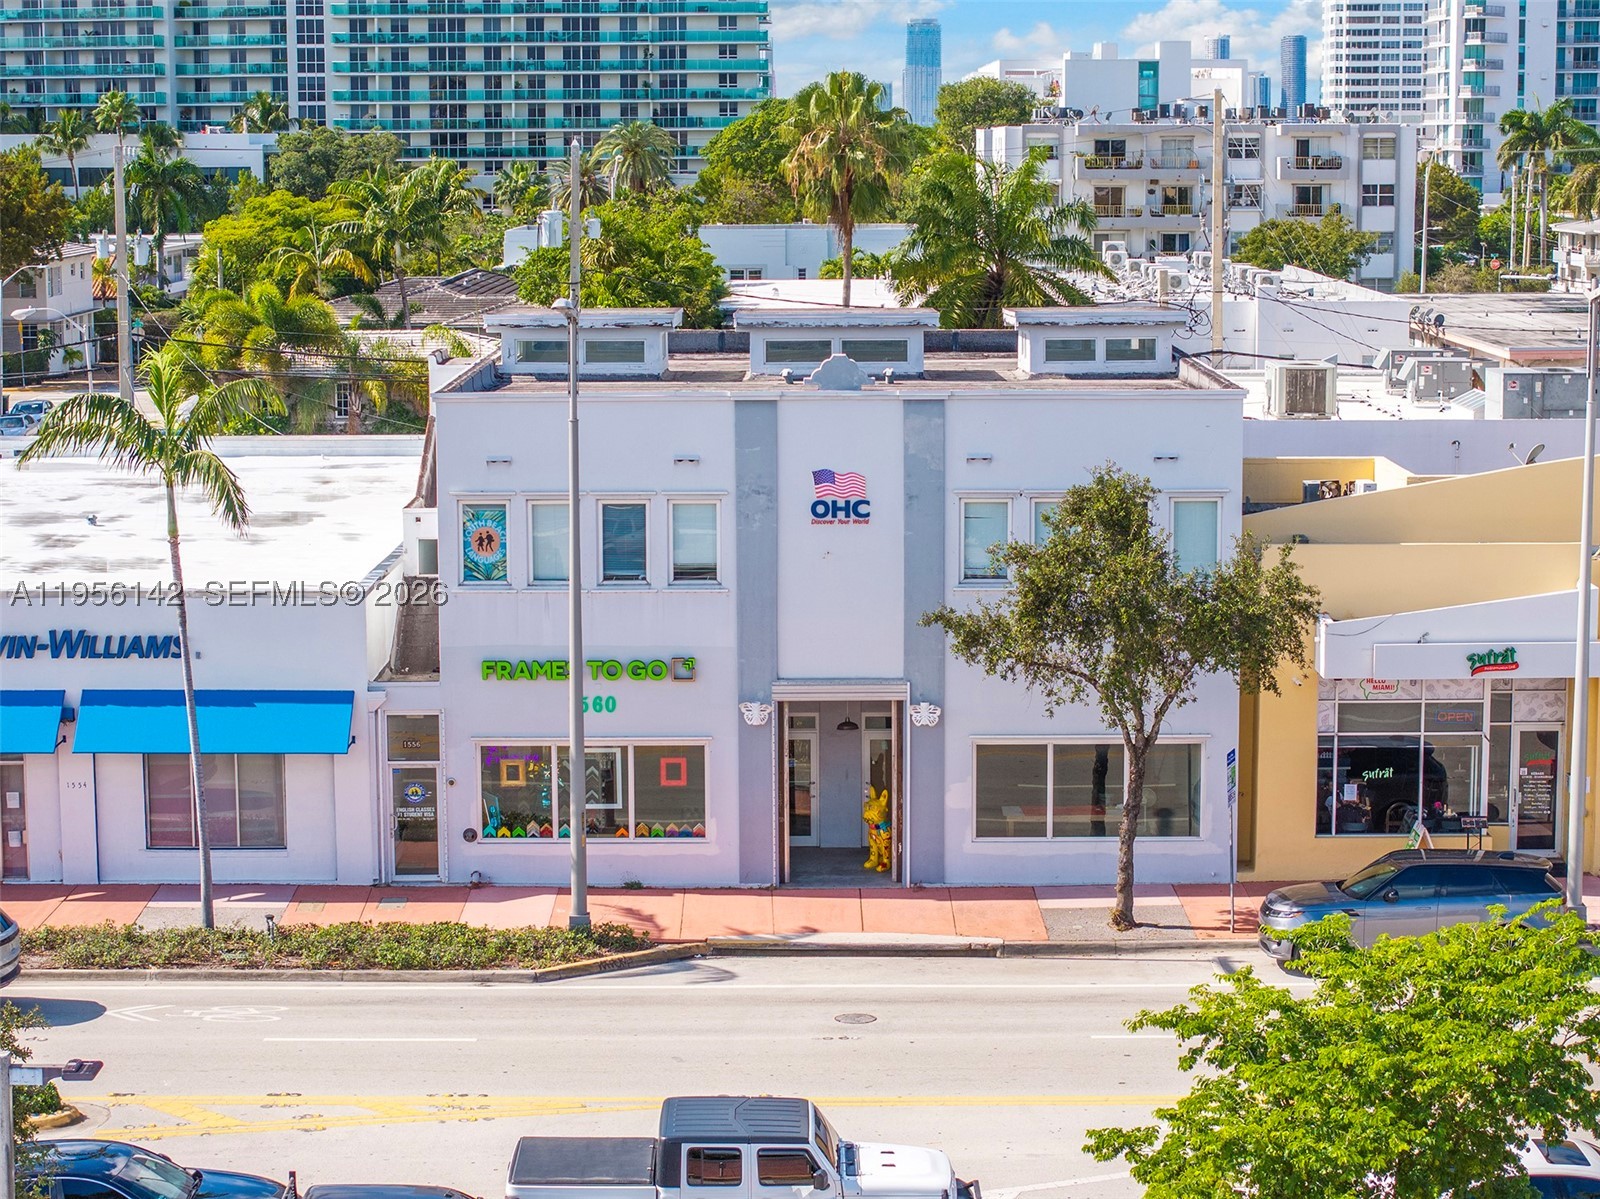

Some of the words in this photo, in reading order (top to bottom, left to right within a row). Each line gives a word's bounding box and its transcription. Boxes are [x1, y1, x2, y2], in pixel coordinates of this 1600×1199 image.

[810, 499, 871, 518] OHC
[465, 519, 486, 542] SOUTH
[486, 519, 507, 543] BEACH
[465, 547, 506, 564] LANGUAGES
[481, 659, 572, 681] FRAME
[586, 659, 623, 681] TO
[626, 659, 669, 681] GO
[1437, 712, 1473, 722] OPEN
